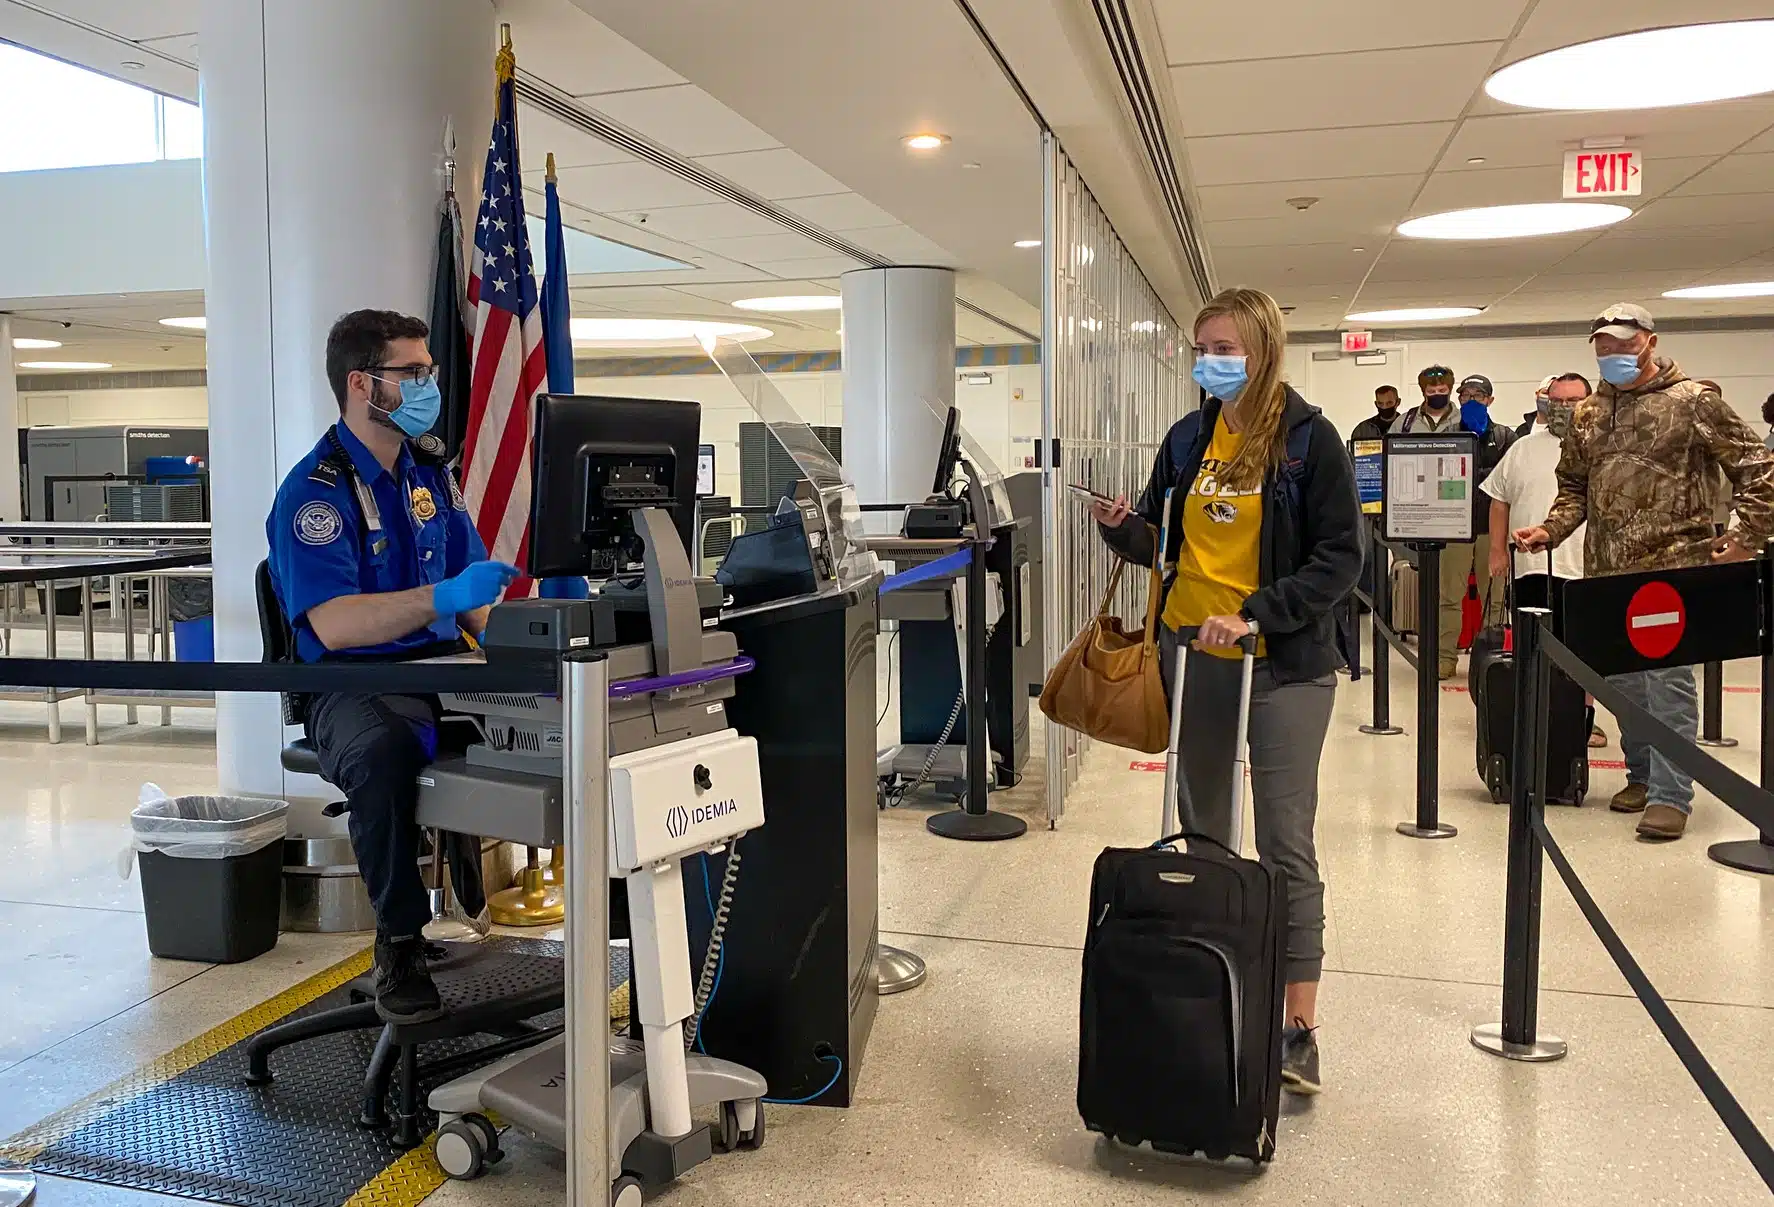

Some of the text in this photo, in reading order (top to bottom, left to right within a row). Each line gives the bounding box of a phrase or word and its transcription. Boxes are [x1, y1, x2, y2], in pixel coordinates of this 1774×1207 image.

[1576, 152, 1633, 193] EXIT
[318, 463, 338, 476] TSA
[546, 735, 563, 743] JAC
[692, 798, 738, 825] IDEMIA
